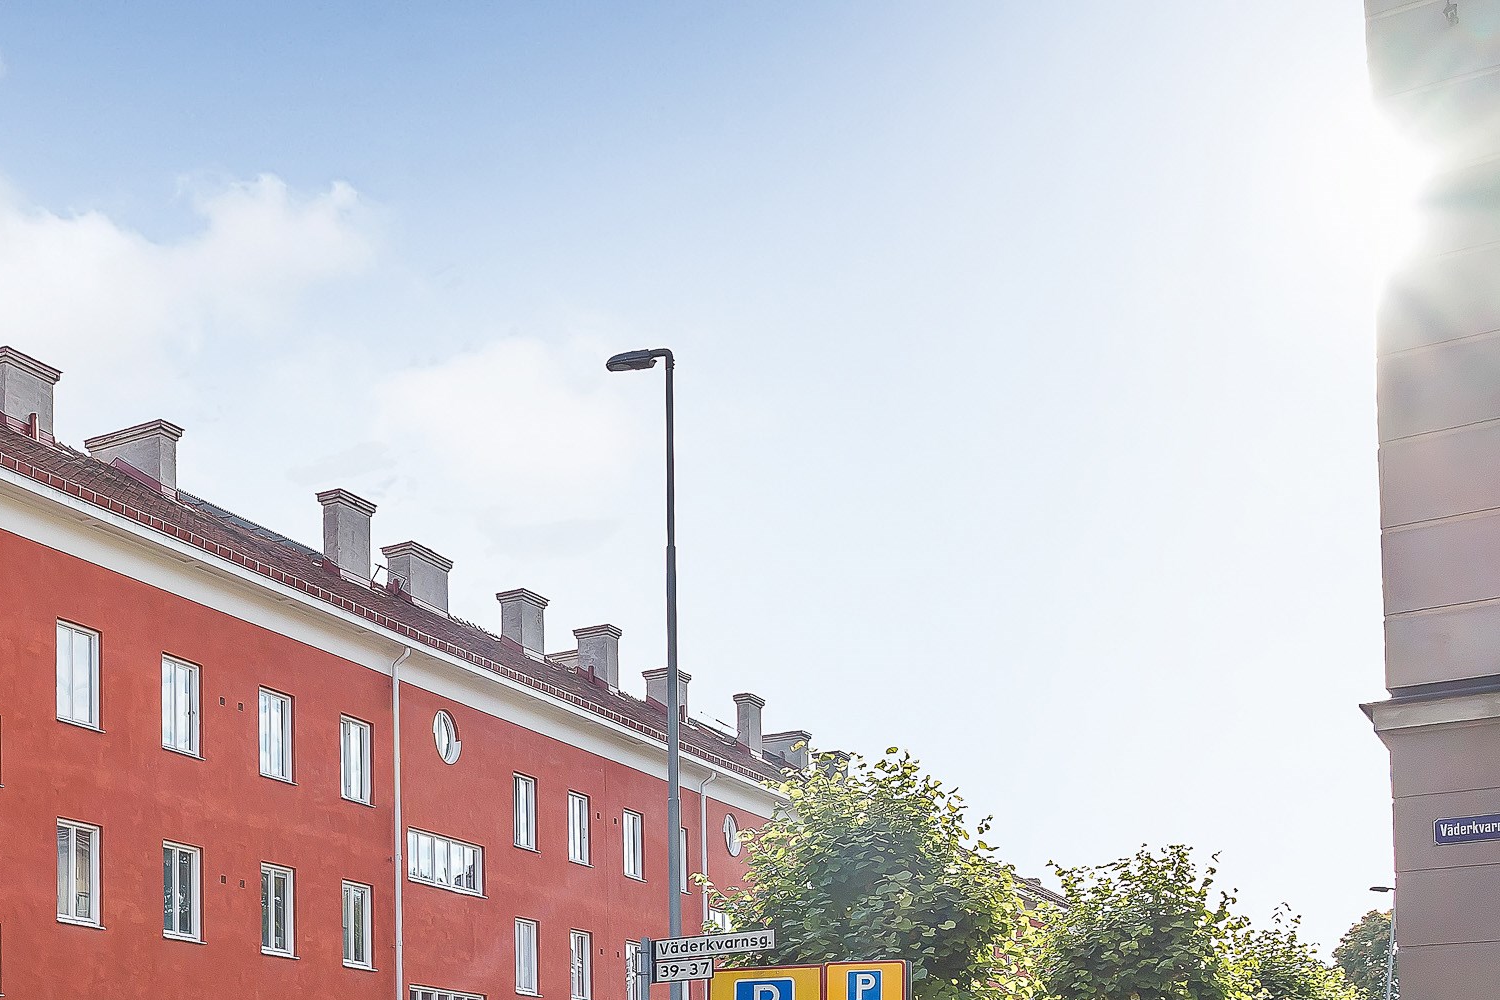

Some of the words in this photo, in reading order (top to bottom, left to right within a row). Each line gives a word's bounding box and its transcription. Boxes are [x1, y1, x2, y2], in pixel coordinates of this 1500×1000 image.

[659, 935, 772, 955] Väderkvarnsg.
[660, 961, 710, 978] 39-37
[855, 973, 876, 1000] P
